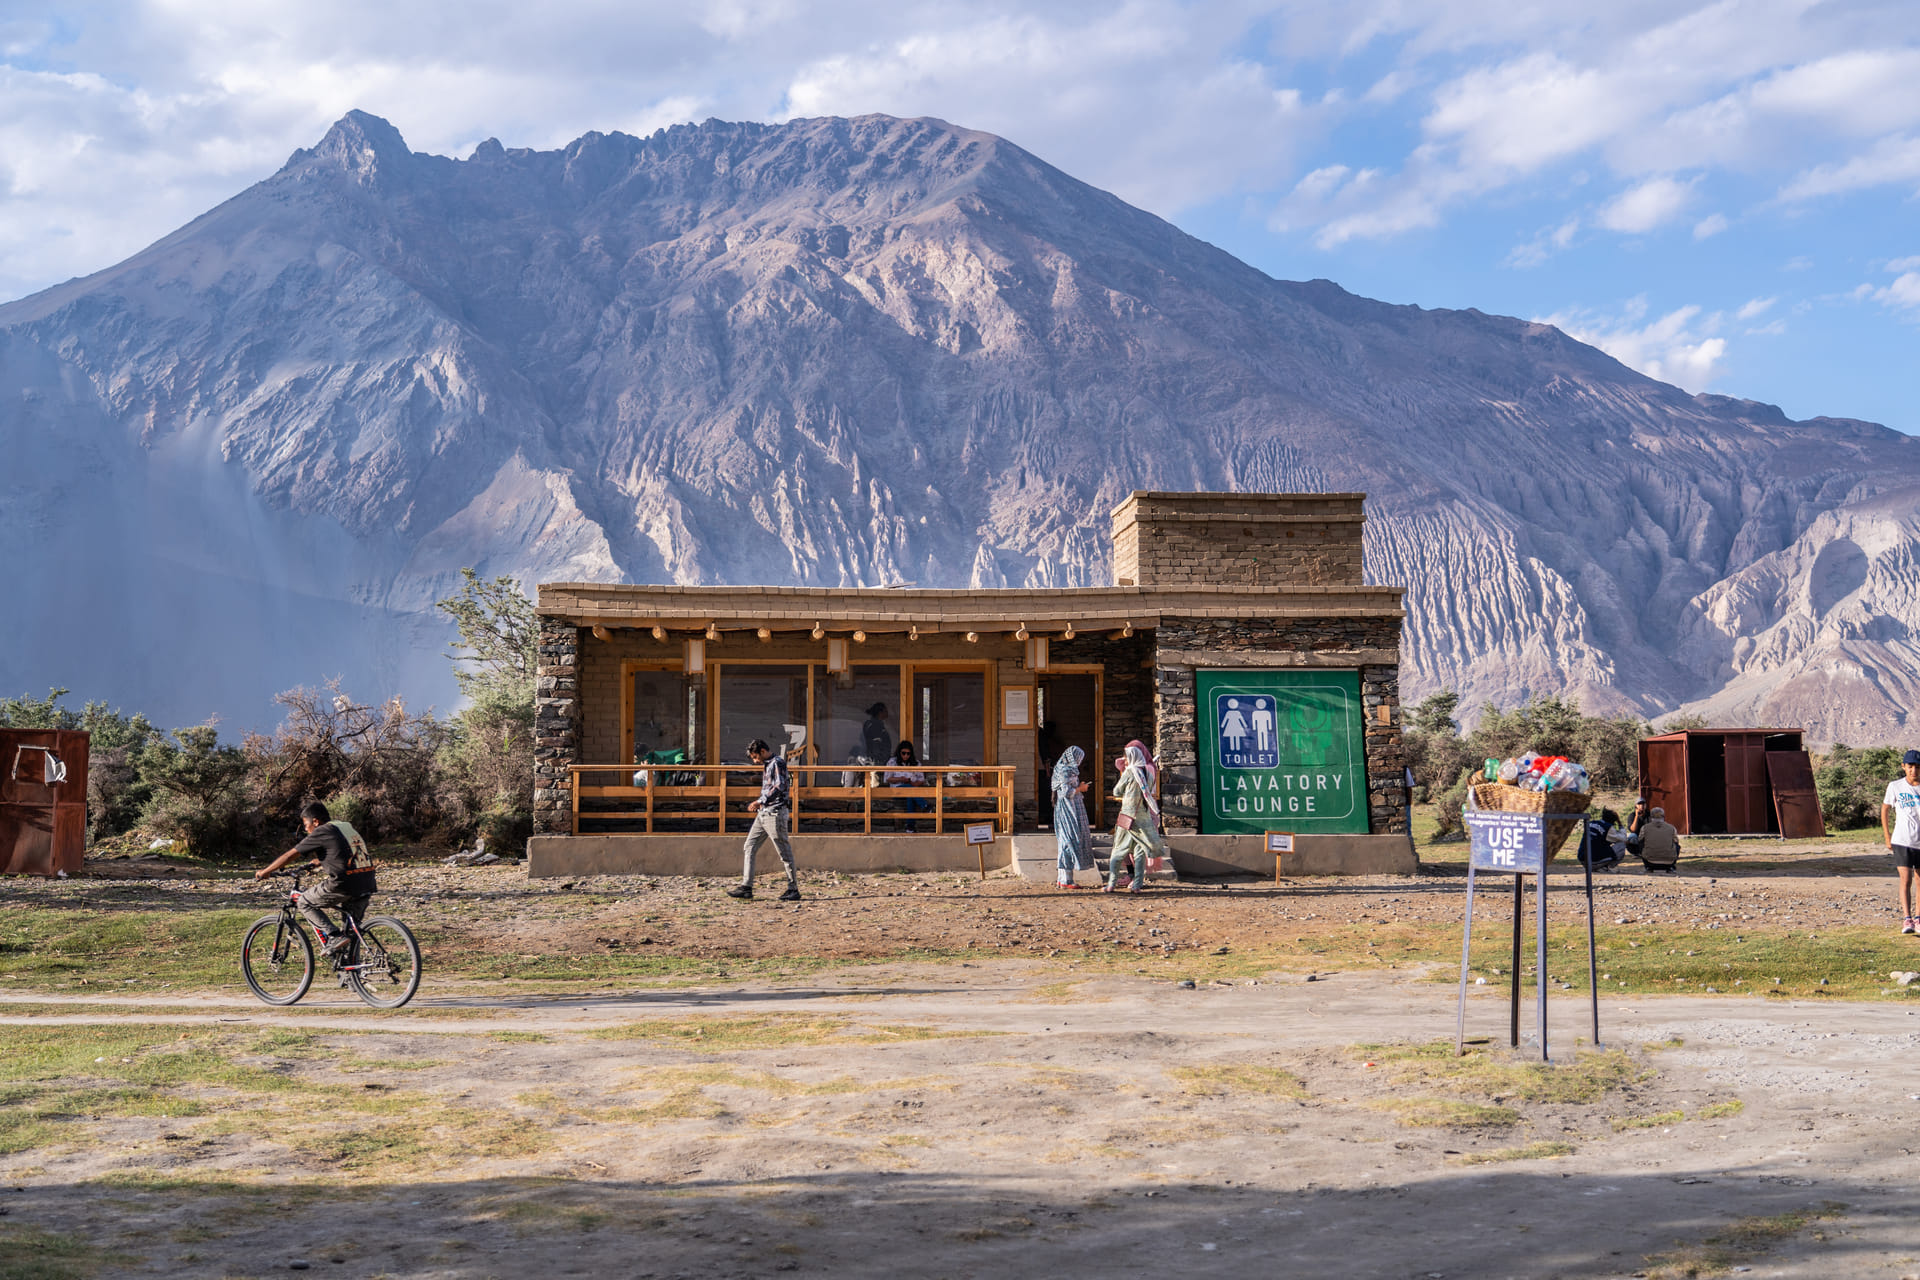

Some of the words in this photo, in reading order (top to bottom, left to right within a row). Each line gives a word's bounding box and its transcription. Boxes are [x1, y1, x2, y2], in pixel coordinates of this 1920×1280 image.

[1225, 754, 1274, 764] TOILET
[1221, 775, 1342, 791] LAVATORY
[1222, 797, 1316, 812] LOUNGE
[1488, 828, 1523, 849] USE
[1492, 849, 1516, 865] ME
